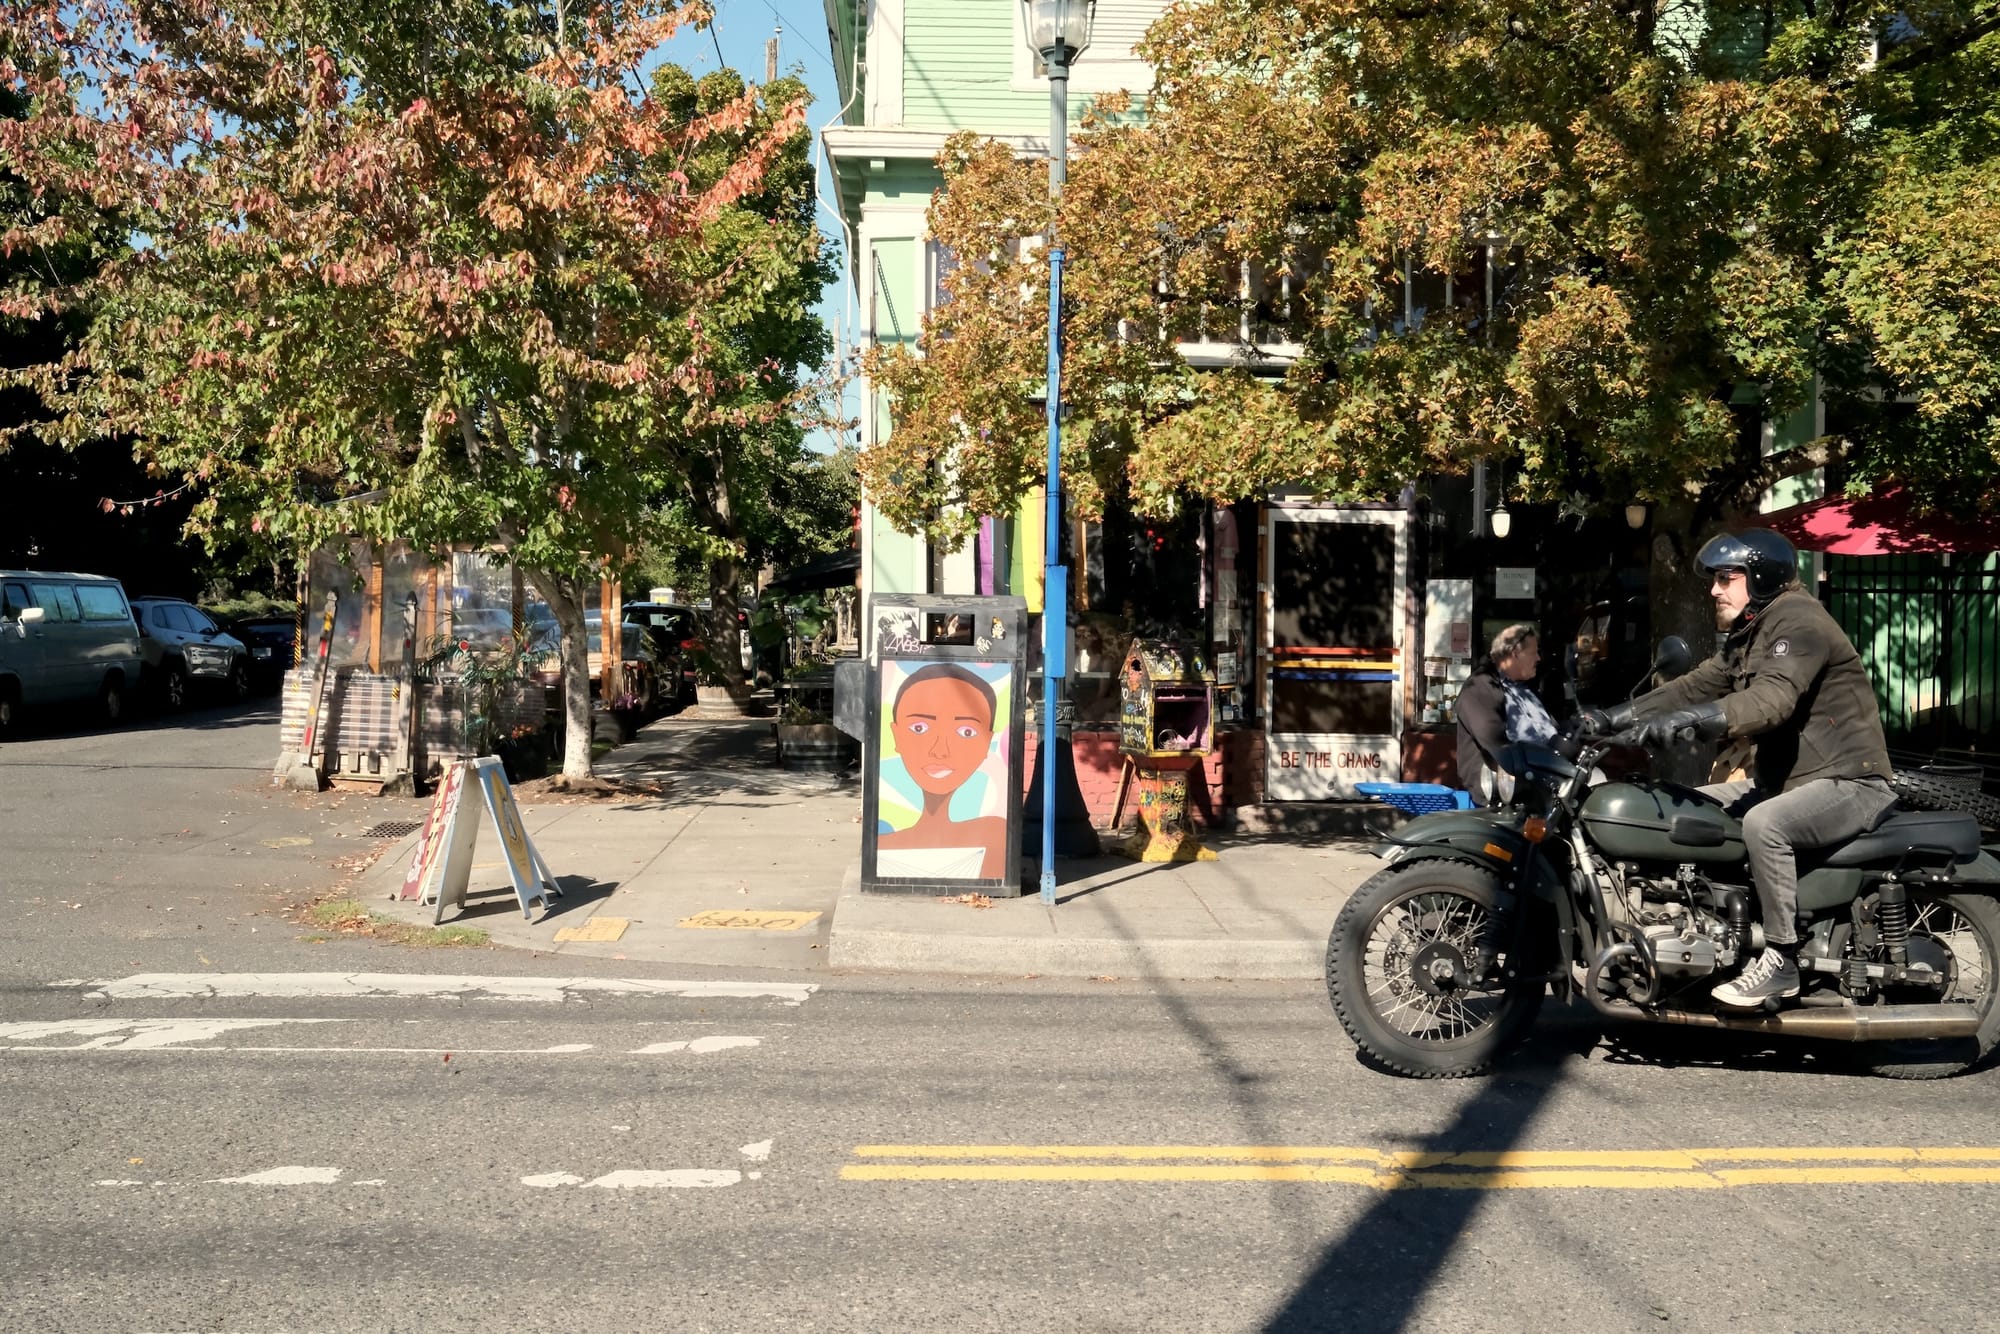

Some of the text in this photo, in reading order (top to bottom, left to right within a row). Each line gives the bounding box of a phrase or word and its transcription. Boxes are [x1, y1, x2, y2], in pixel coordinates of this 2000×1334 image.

[1280, 751, 1381, 768] BE THE CHANG
